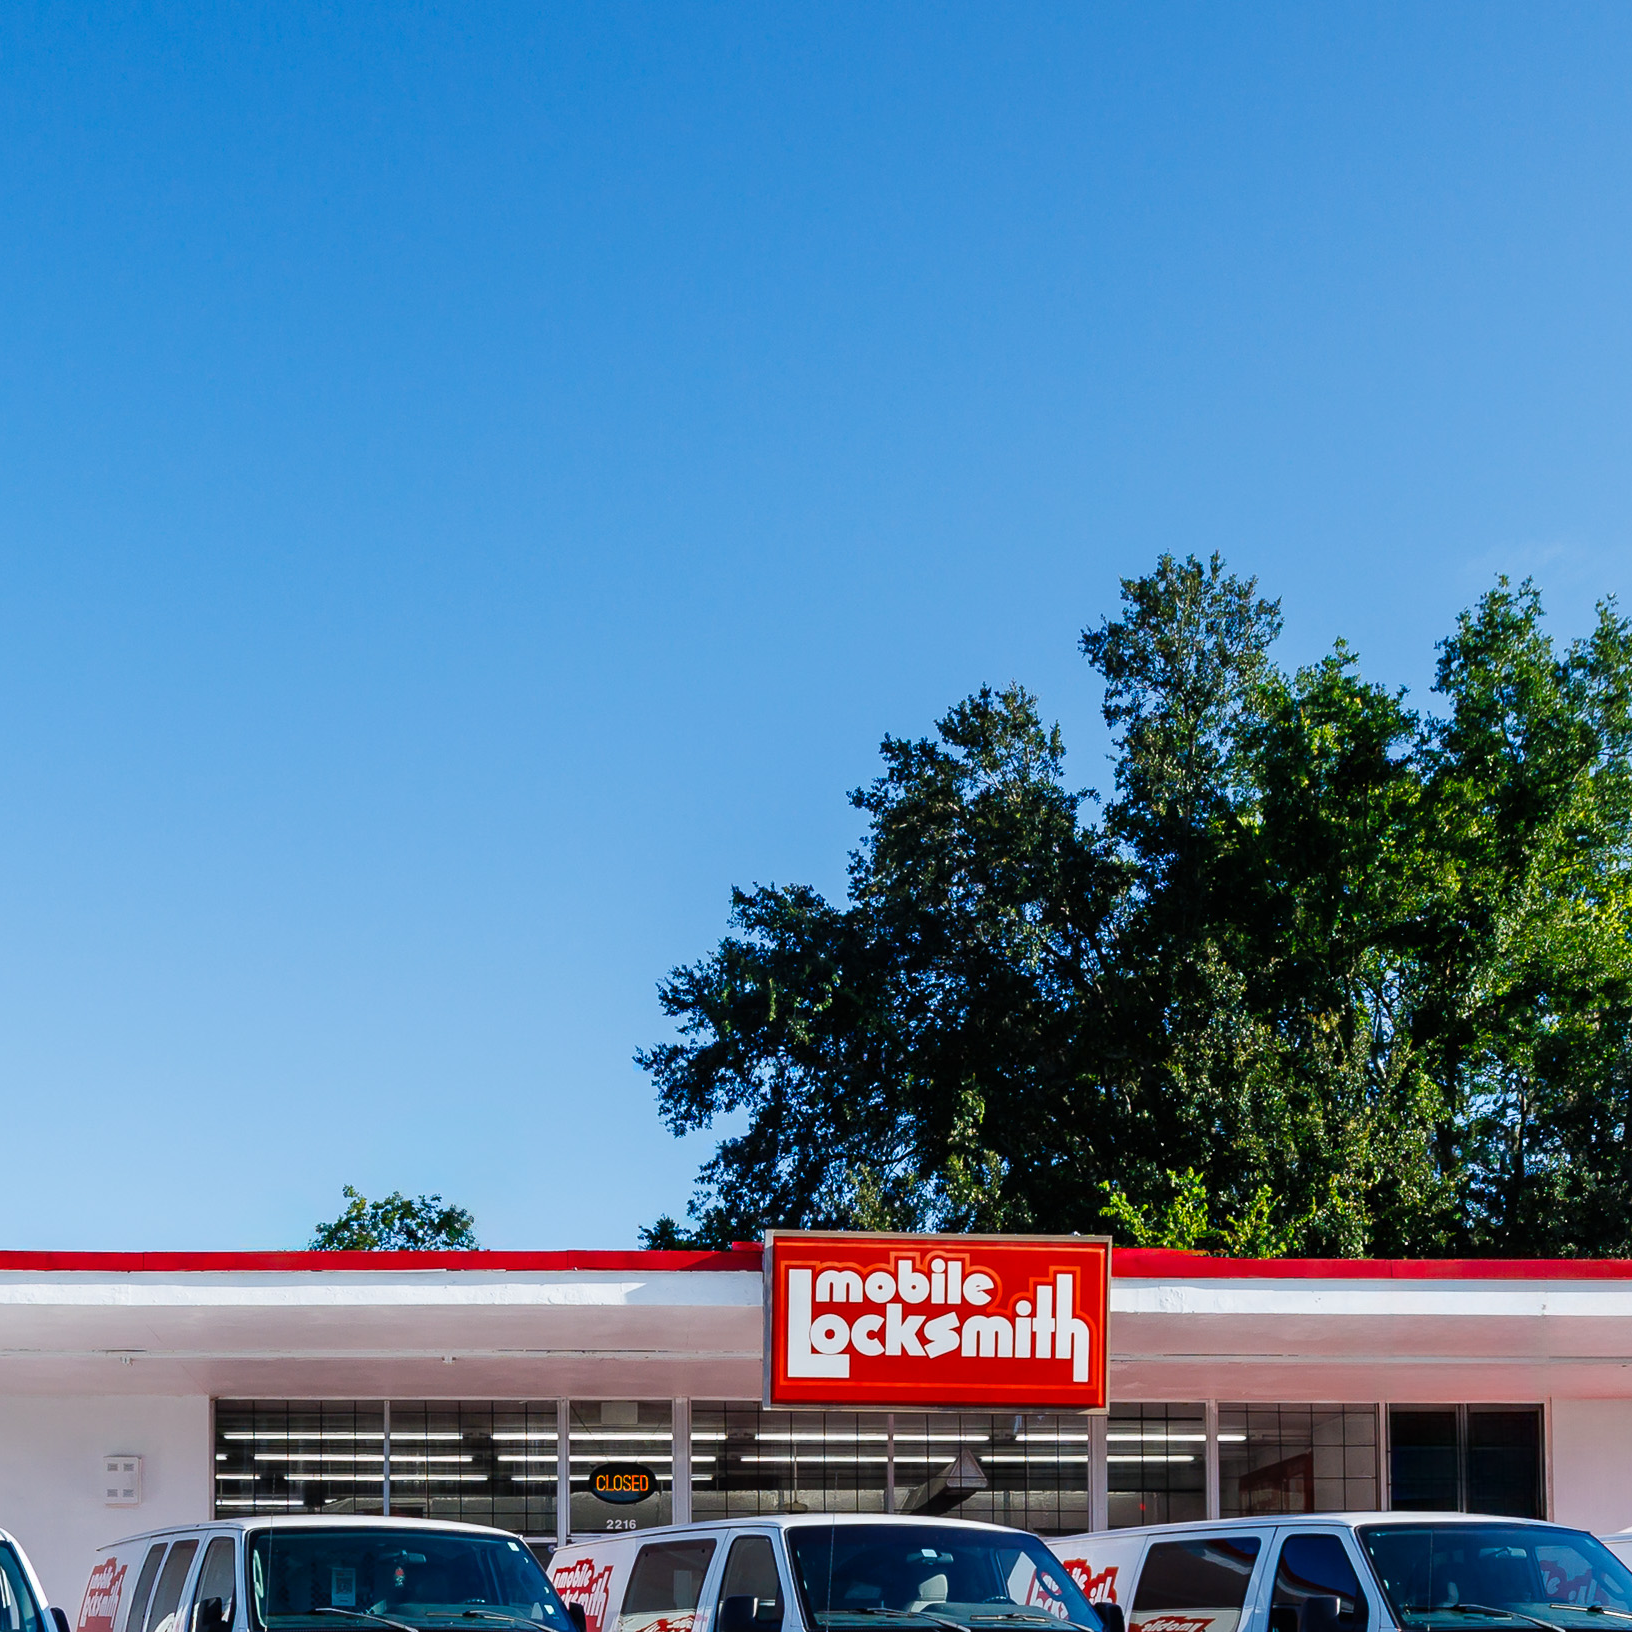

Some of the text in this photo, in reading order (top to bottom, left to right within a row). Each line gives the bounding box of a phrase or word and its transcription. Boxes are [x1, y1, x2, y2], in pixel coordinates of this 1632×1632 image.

[816, 1258, 994, 1306] mobile
[788, 1268, 1090, 1382] Locksmith
[596, 1474, 649, 1492] CLOSED
[606, 1519, 637, 1530] 2216
[558, 1563, 592, 1588] mobile
